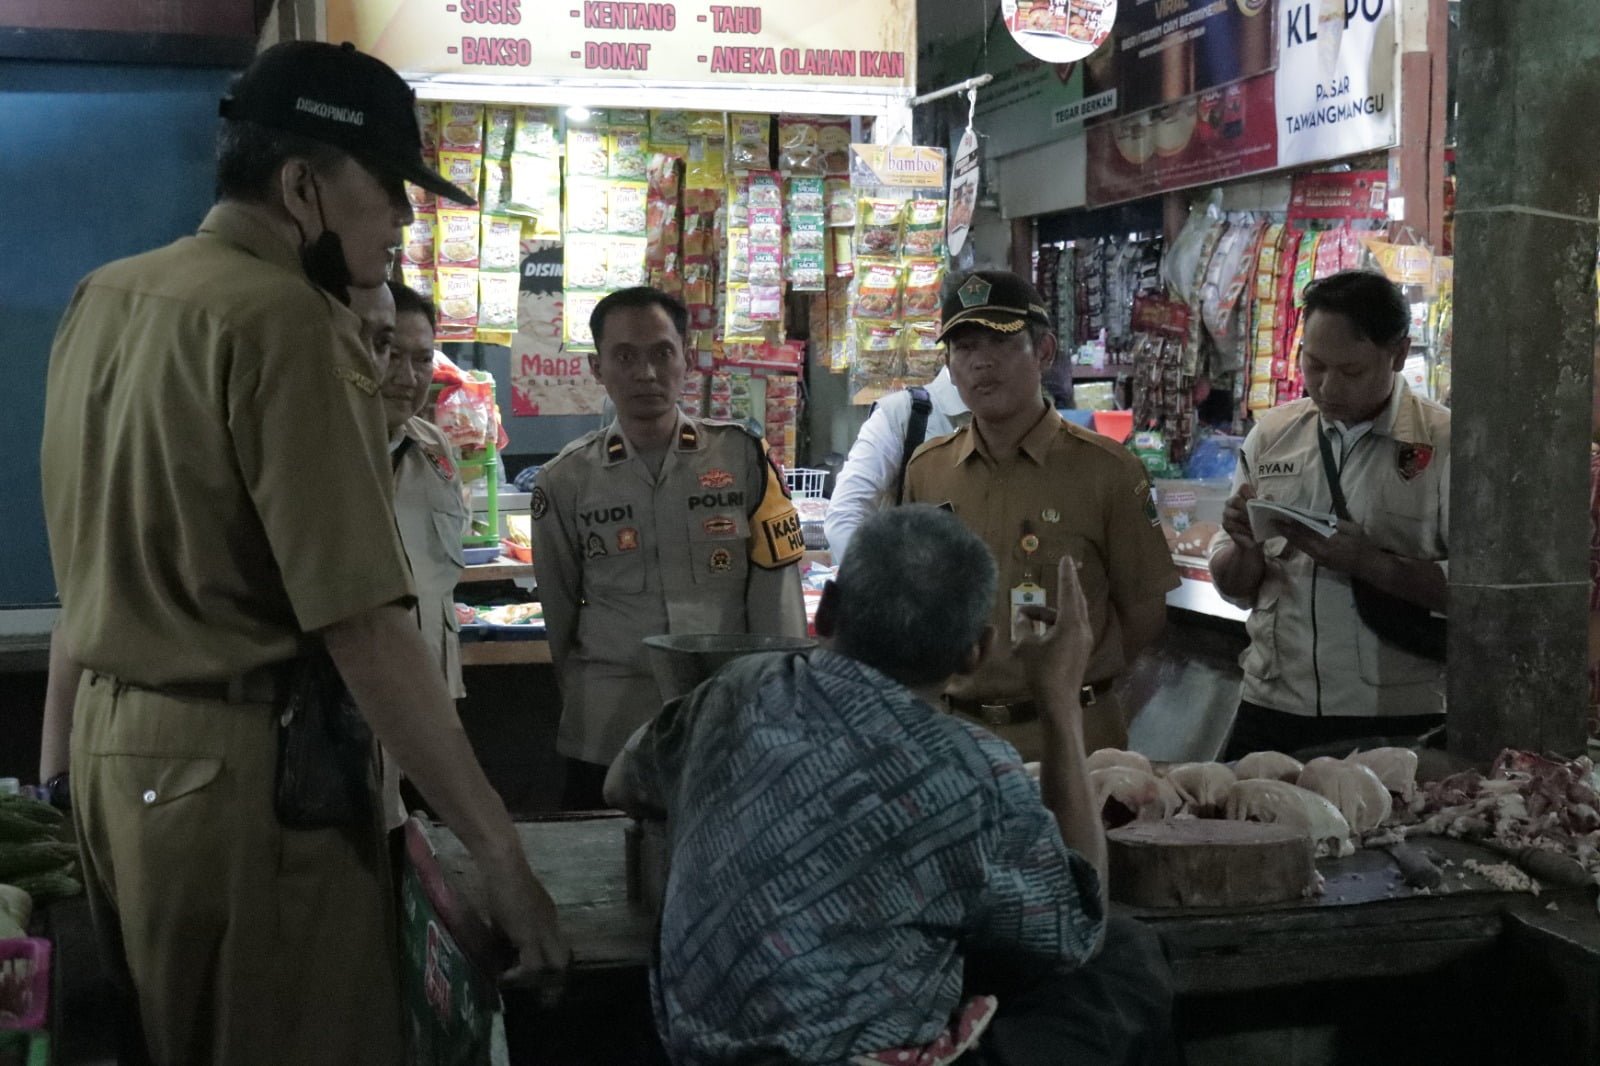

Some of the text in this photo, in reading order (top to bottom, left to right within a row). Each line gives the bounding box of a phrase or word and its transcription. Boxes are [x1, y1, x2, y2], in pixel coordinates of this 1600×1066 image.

[461, 0, 521, 25] SOSIS
[584, 1, 676, 31] KENTANG
[710, 5, 762, 34] TAHU
[1287, 0, 1384, 48] KLPO
[462, 37, 531, 66] BAKSO
[584, 41, 651, 70] DONAT
[710, 46, 905, 78] ANEKA OLAHAN IKAN
[1055, 105, 1080, 124] TEGAR
[1285, 93, 1385, 134] TAWANGMANGU
[888, 150, 938, 172] bamboe
[521, 353, 582, 377] Mang
[1258, 463, 1295, 475] RYAN
[688, 491, 744, 510] POLRI
[579, 504, 633, 527] YUDI
